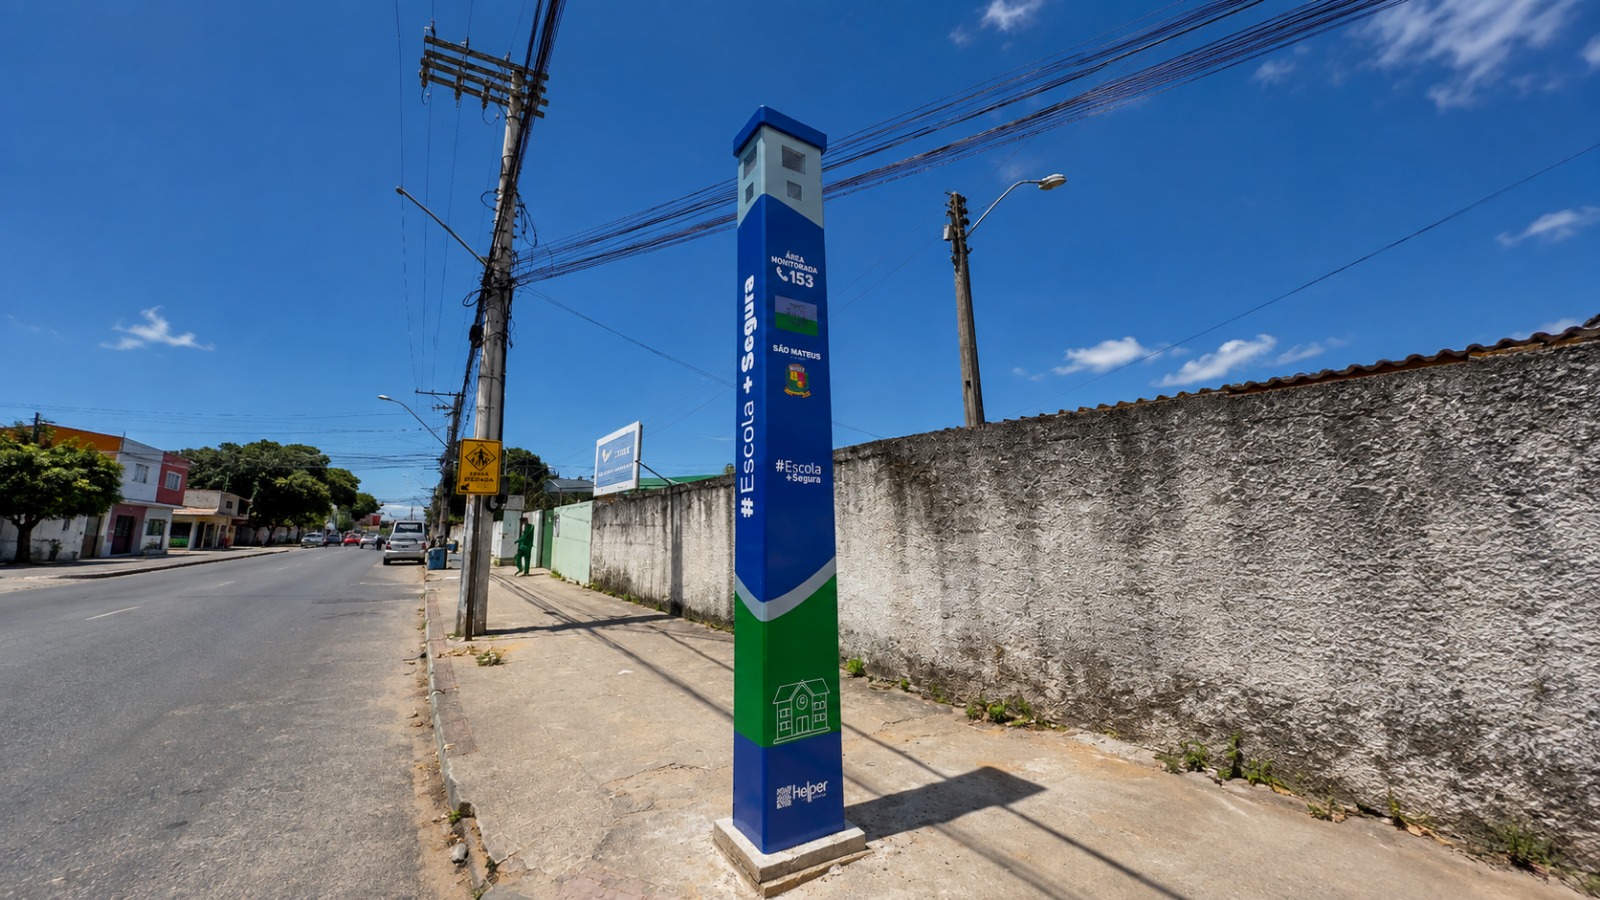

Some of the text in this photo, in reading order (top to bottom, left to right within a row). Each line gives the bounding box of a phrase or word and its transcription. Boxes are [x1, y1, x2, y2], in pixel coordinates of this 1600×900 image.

[771, 256, 818, 274] MONITORADA
[785, 250, 805, 263] ÁREA
[789, 270, 814, 288] 153
[741, 275, 757, 373] Segura
[773, 344, 821, 360] SÃO MATEUS
[776, 459, 821, 475] #Escola
[792, 780, 828, 803] Helper
